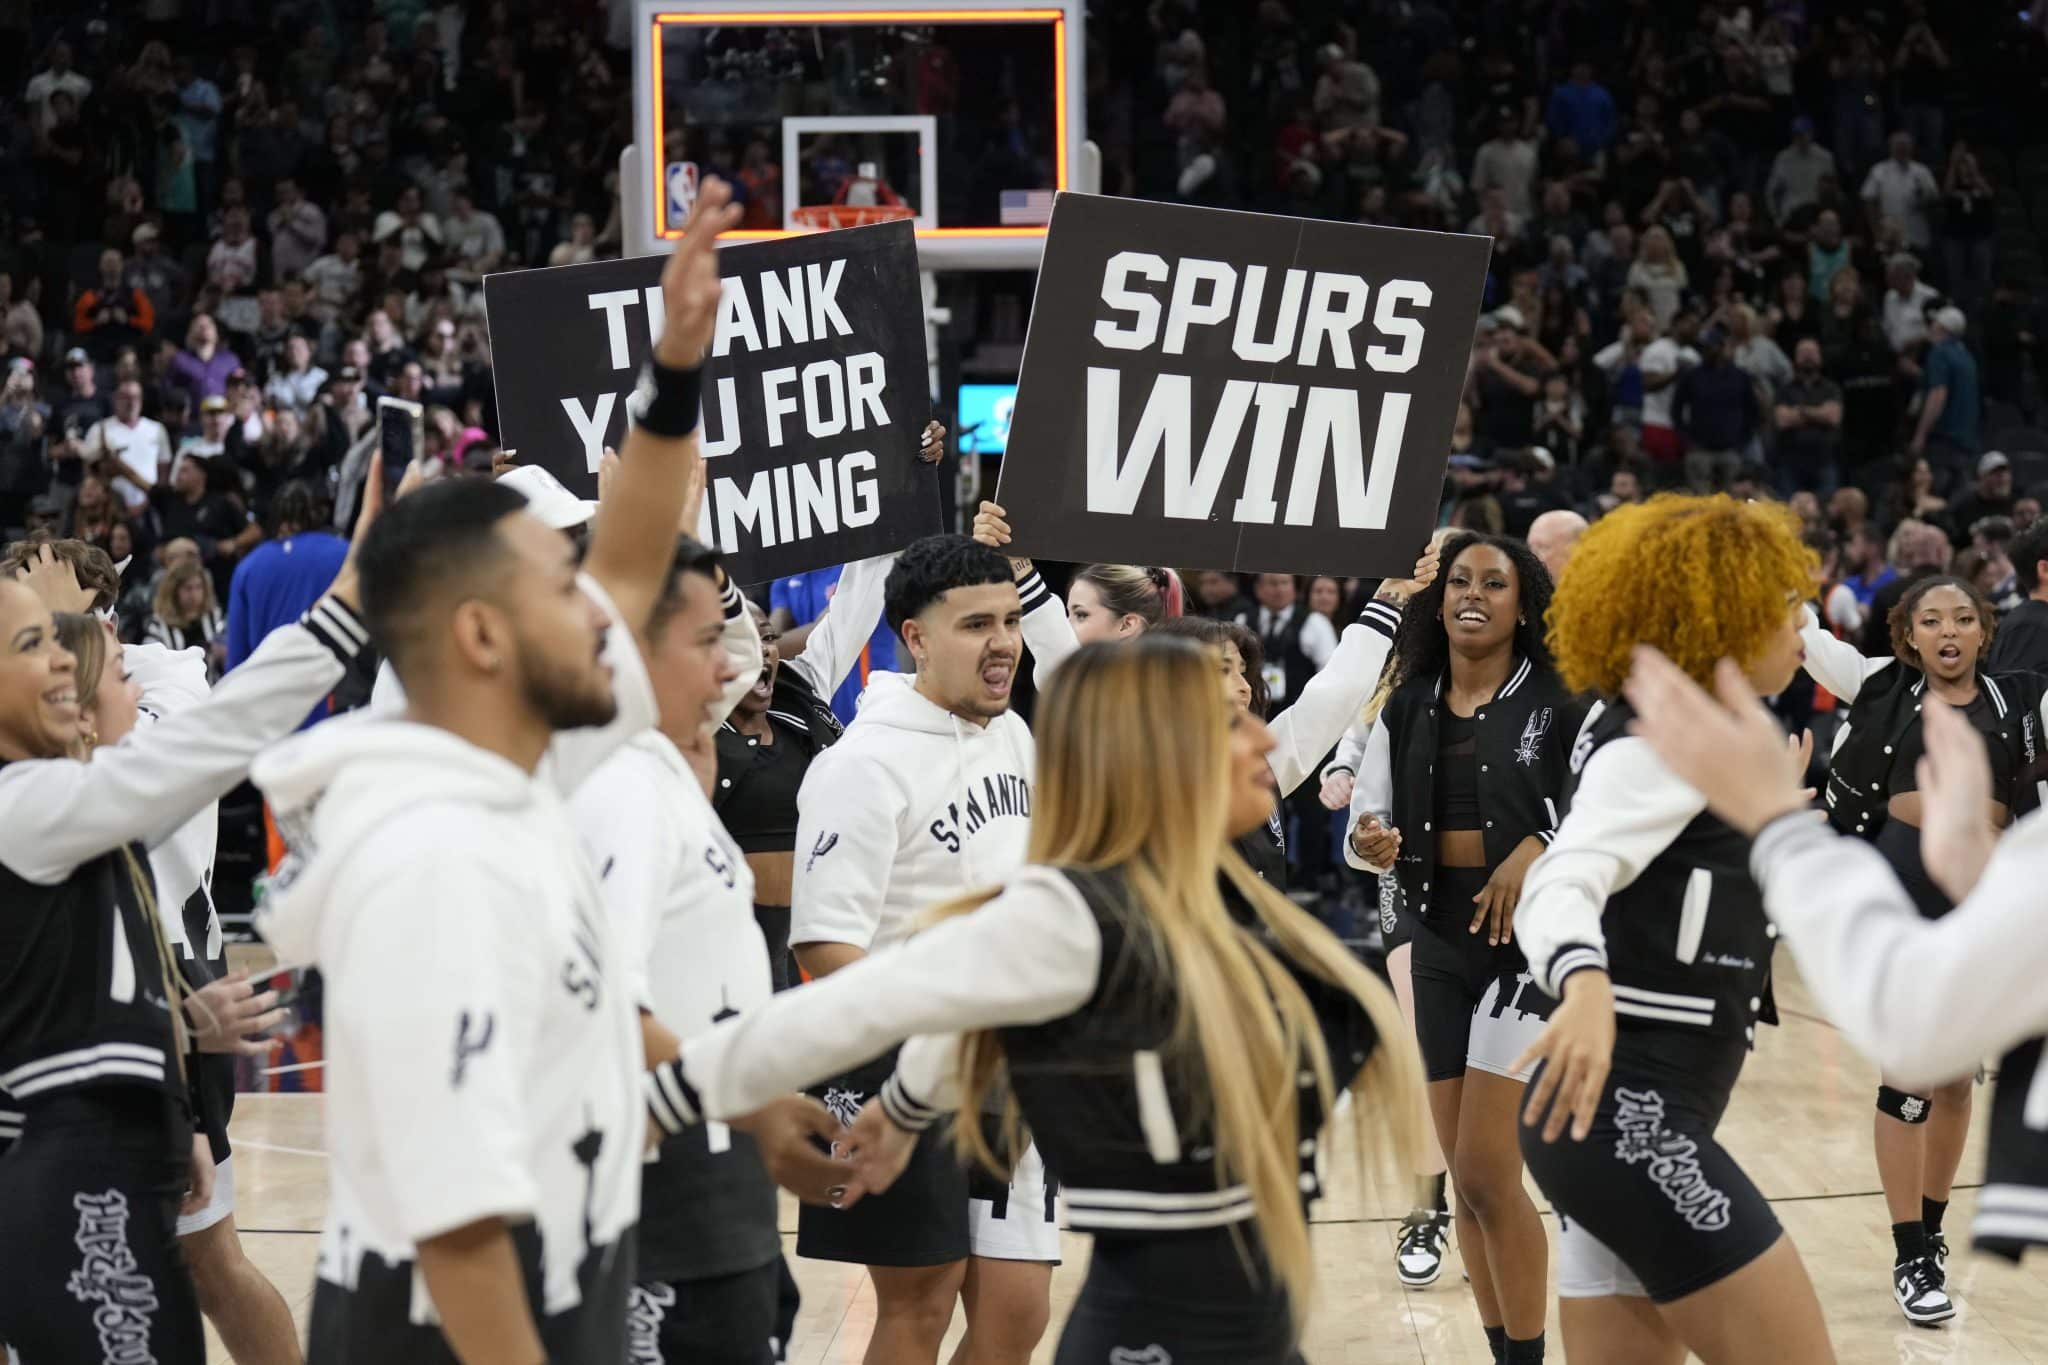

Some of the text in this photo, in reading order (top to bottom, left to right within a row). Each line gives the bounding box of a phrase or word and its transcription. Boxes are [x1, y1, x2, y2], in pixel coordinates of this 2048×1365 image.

[1093, 250, 1433, 374] SPURS
[560, 351, 891, 475] YU FOR
[1086, 366, 1412, 531] WIN
[699, 449, 881, 554] MING
